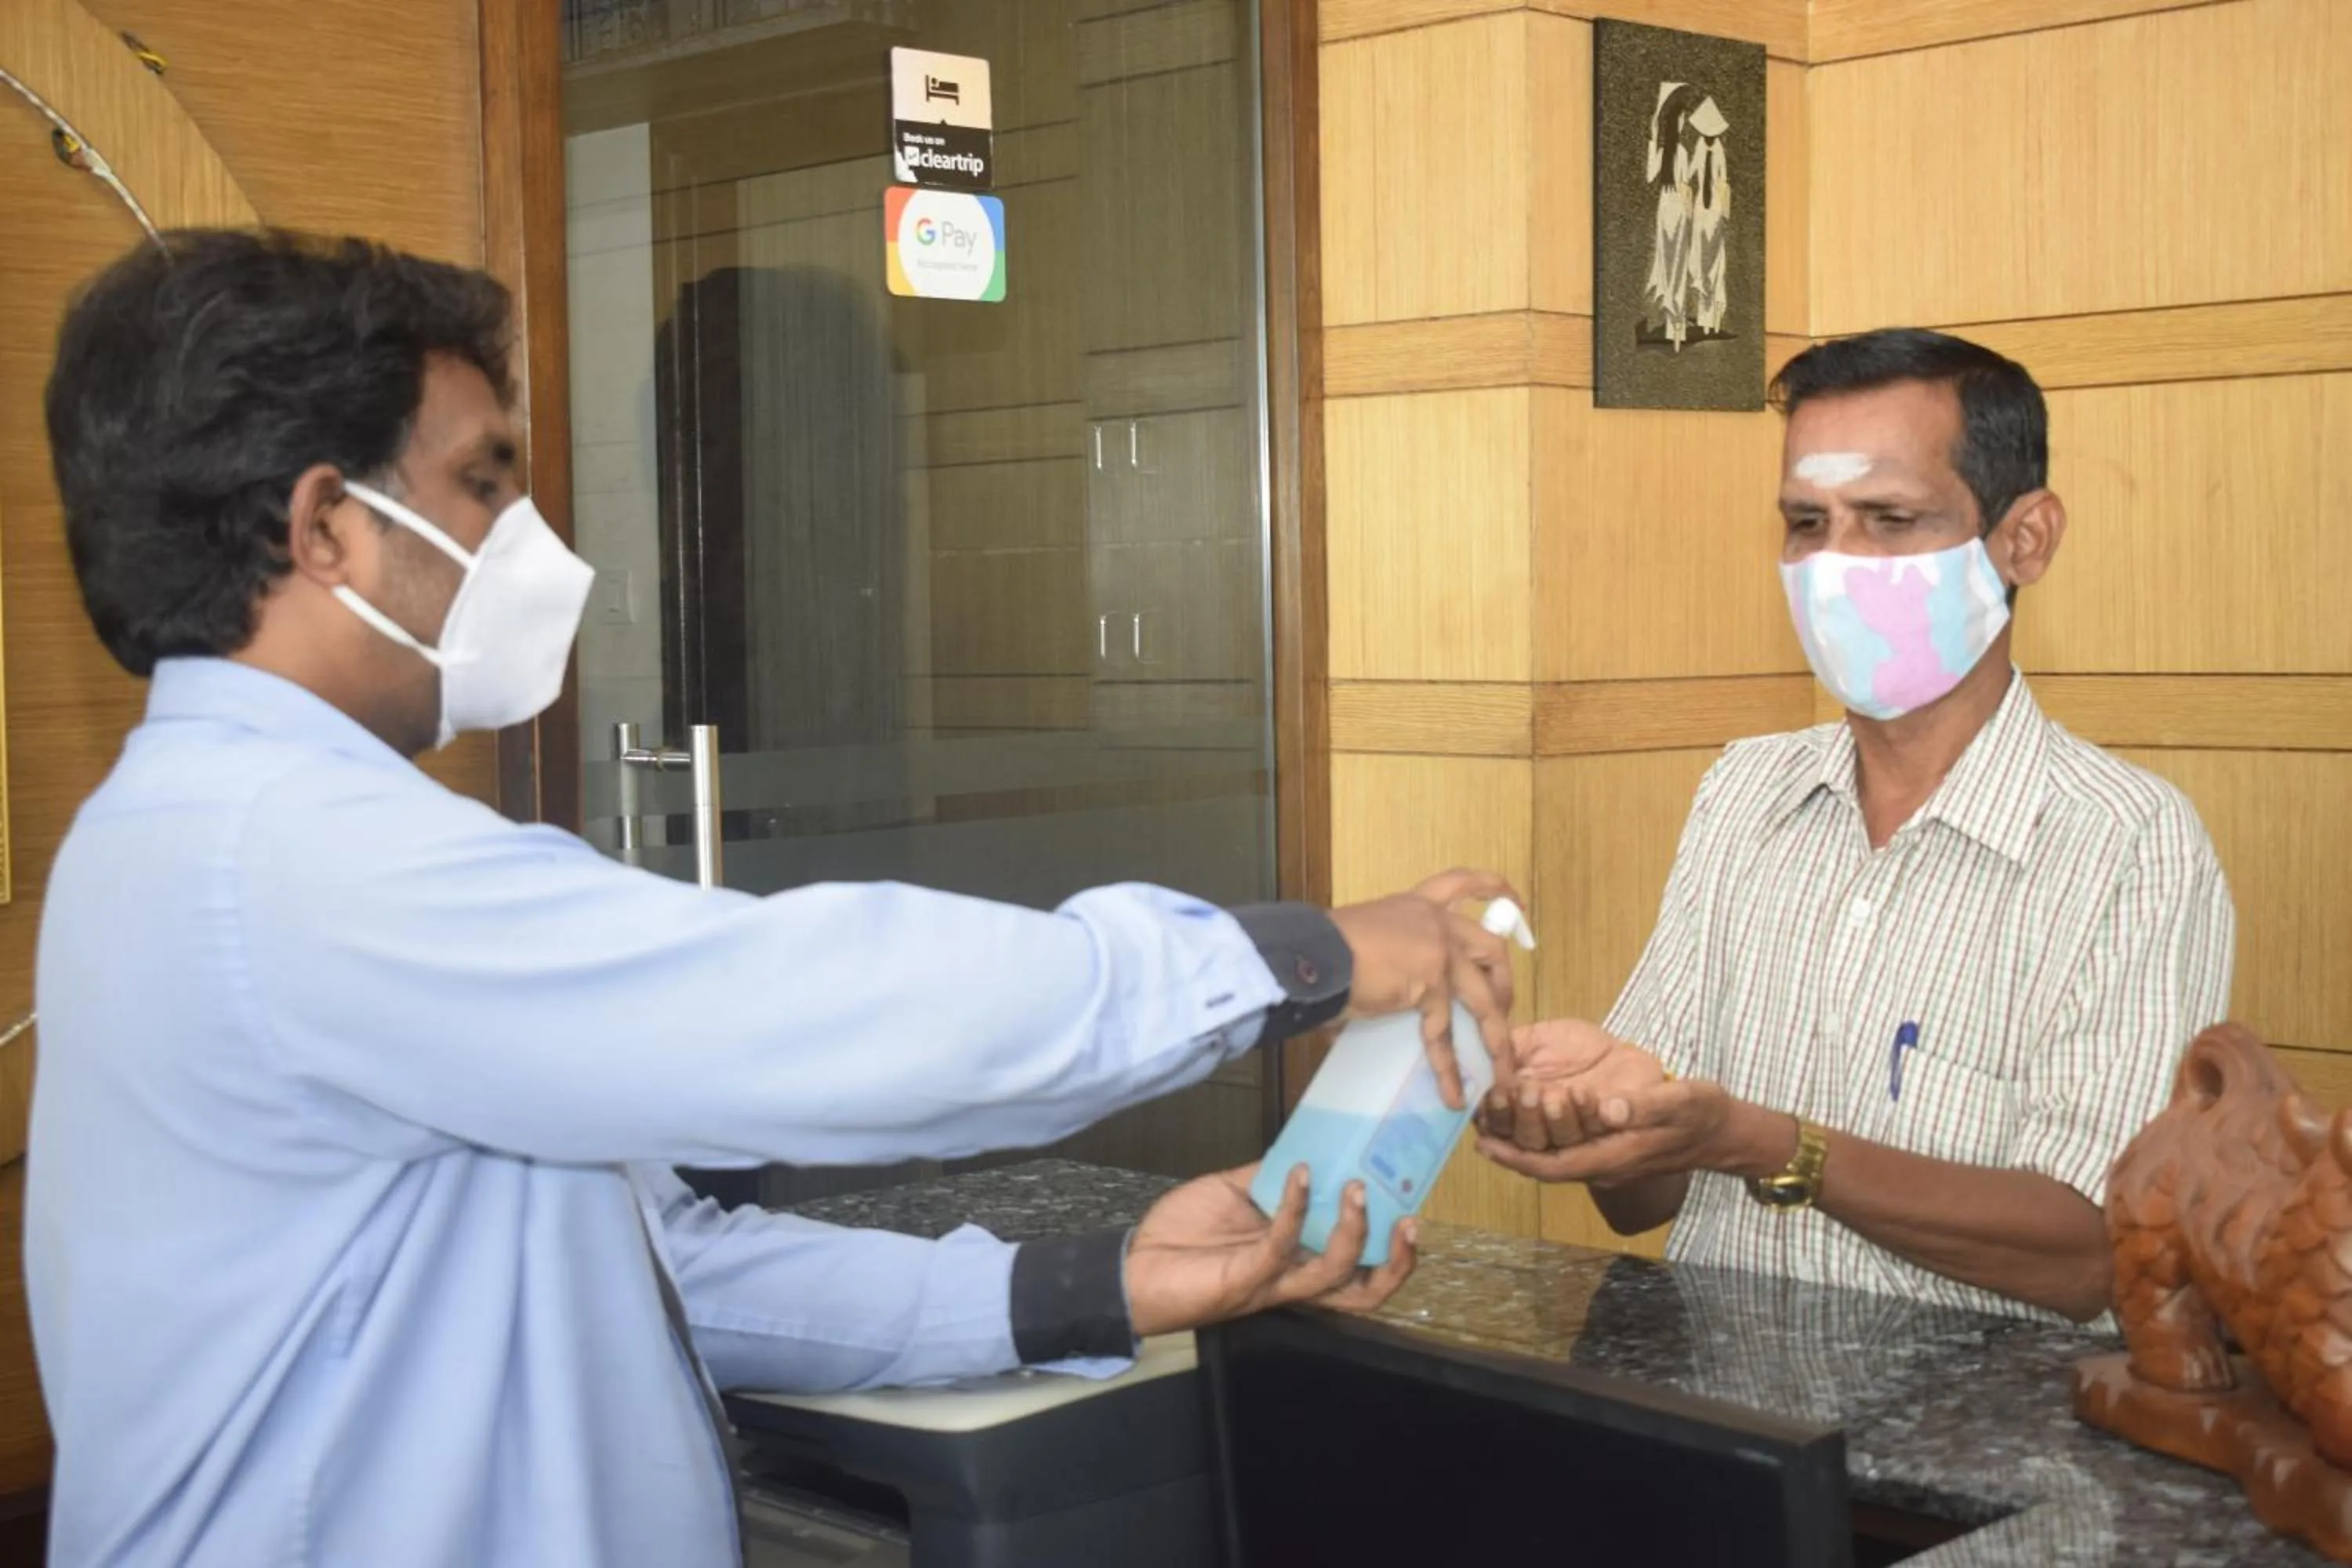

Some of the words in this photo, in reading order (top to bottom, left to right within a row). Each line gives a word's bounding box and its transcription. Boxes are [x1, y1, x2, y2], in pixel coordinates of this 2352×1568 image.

[920, 147, 984, 176] cleartrip
[916, 218, 936, 245] G
[942, 220, 977, 257] Pay
